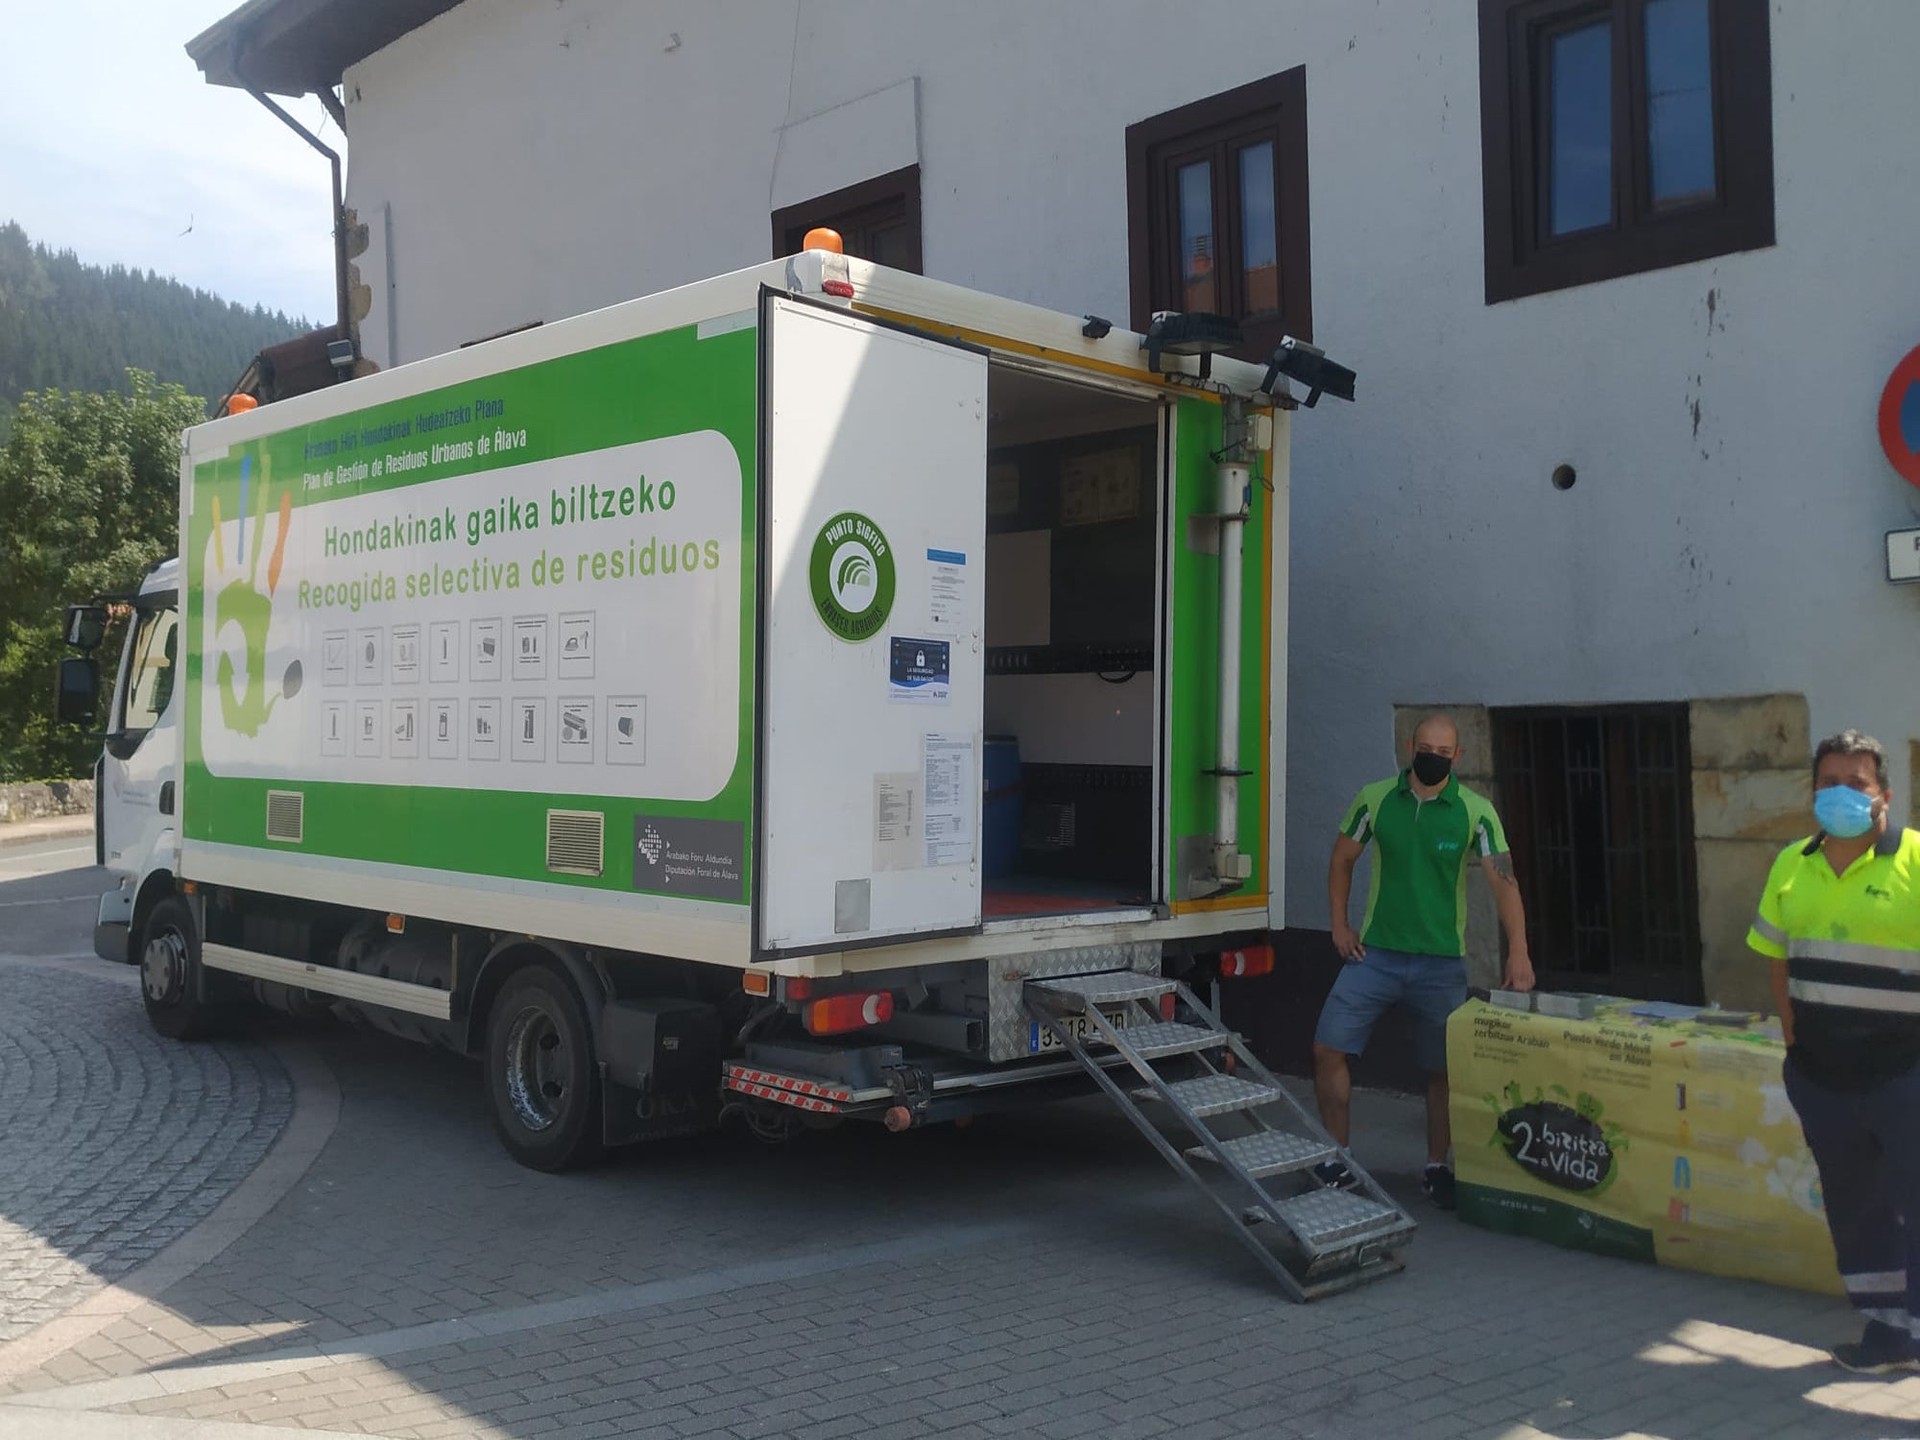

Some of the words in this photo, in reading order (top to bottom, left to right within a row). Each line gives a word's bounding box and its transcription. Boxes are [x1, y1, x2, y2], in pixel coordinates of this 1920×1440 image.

[475, 398, 504, 420] Plana
[303, 472, 321, 492] Plan
[323, 468, 334, 488] de
[336, 460, 369, 485] Gestión
[372, 457, 383, 478] de
[385, 449, 428, 475] Residuos
[431, 441, 473, 465] Urbanos
[477, 434, 490, 456] de
[324, 506, 458, 558] Hondakinak
[466, 495, 539, 546] gaika
[550, 473, 677, 526] biltzeko
[825, 518, 853, 546] PUNTO
[856, 519, 886, 557] SIGFITO
[298, 569, 397, 613] Recogida
[405, 555, 521, 599] selectiva
[531, 548, 565, 587] de
[576, 535, 722, 583] residuos
[821, 597, 849, 633] ENVASES
[850, 605, 884, 635] AGRARIOS
[665, 863, 696, 876] Diputación
[697, 867, 712, 878] Foral
[713, 868, 721, 878] de
[666, 850, 690, 861] Arabako
[691, 852, 704, 863] Foru
[1517, 1034, 1551, 1049] Araban
[1543, 1122, 1610, 1157] bizitza
